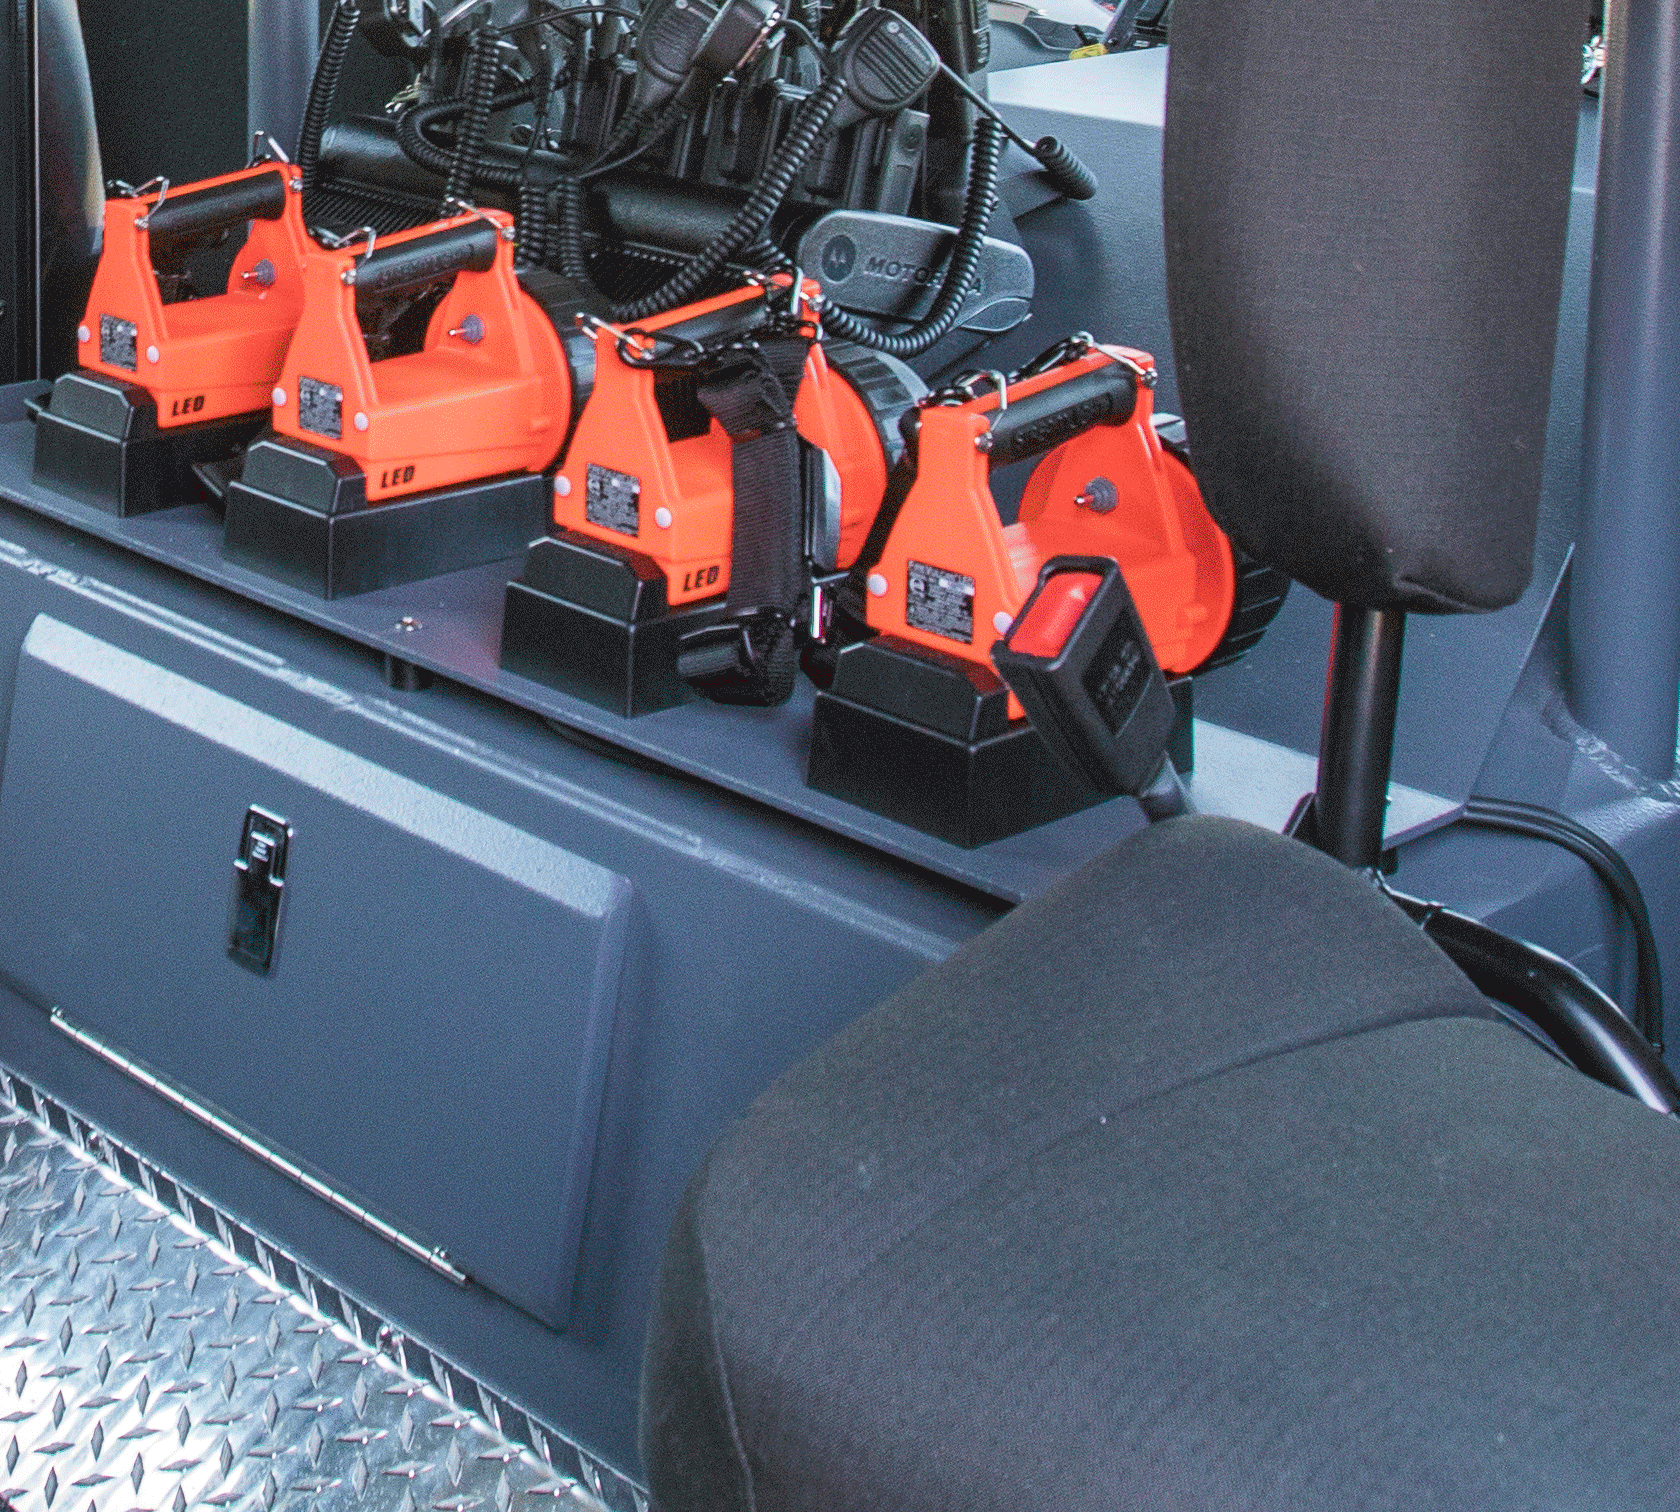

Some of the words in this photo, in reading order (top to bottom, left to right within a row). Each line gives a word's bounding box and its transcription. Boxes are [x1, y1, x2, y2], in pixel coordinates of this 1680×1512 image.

[863, 256, 983, 296] MOTORA
[171, 394, 206, 417] LED
[379, 464, 416, 489] LED
[681, 564, 721, 594] LED
